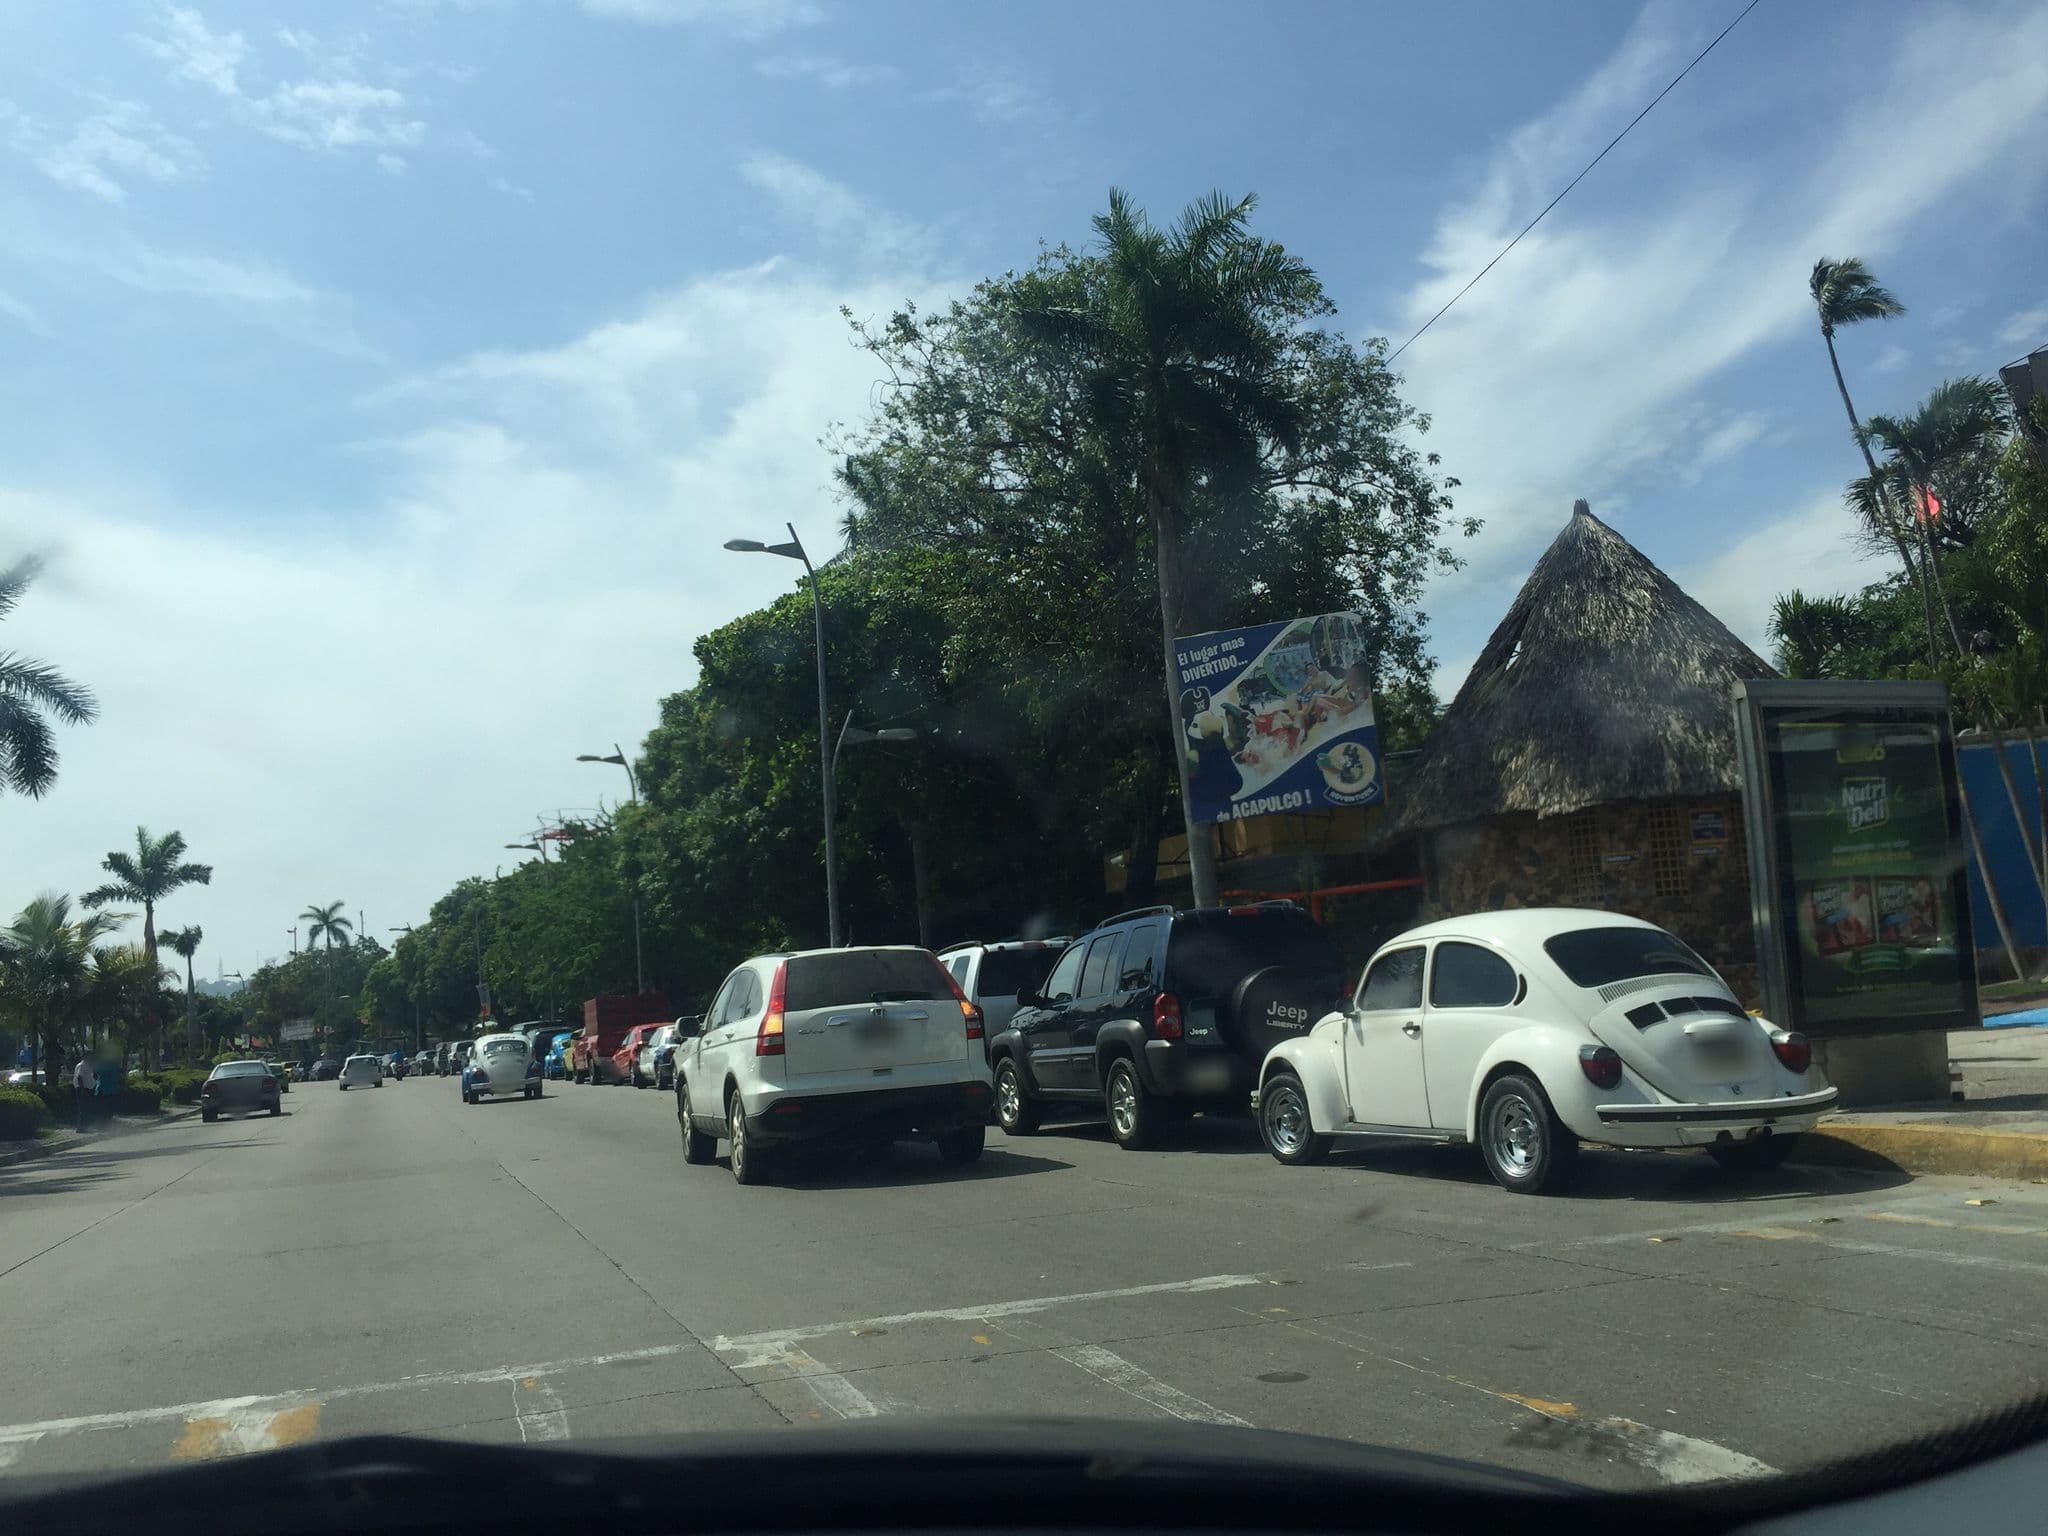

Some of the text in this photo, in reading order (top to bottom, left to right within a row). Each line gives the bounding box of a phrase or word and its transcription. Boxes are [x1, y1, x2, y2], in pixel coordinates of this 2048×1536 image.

[1177, 636, 1246, 666] El lugar mas
[1232, 791, 1301, 819] ACAPULCO
[1842, 783, 1888, 808] Nutri
[1266, 1000, 1308, 1023] Jeep
[1189, 1027, 1209, 1036] Jeep
[1266, 1019, 1305, 1030] LIBERTY
